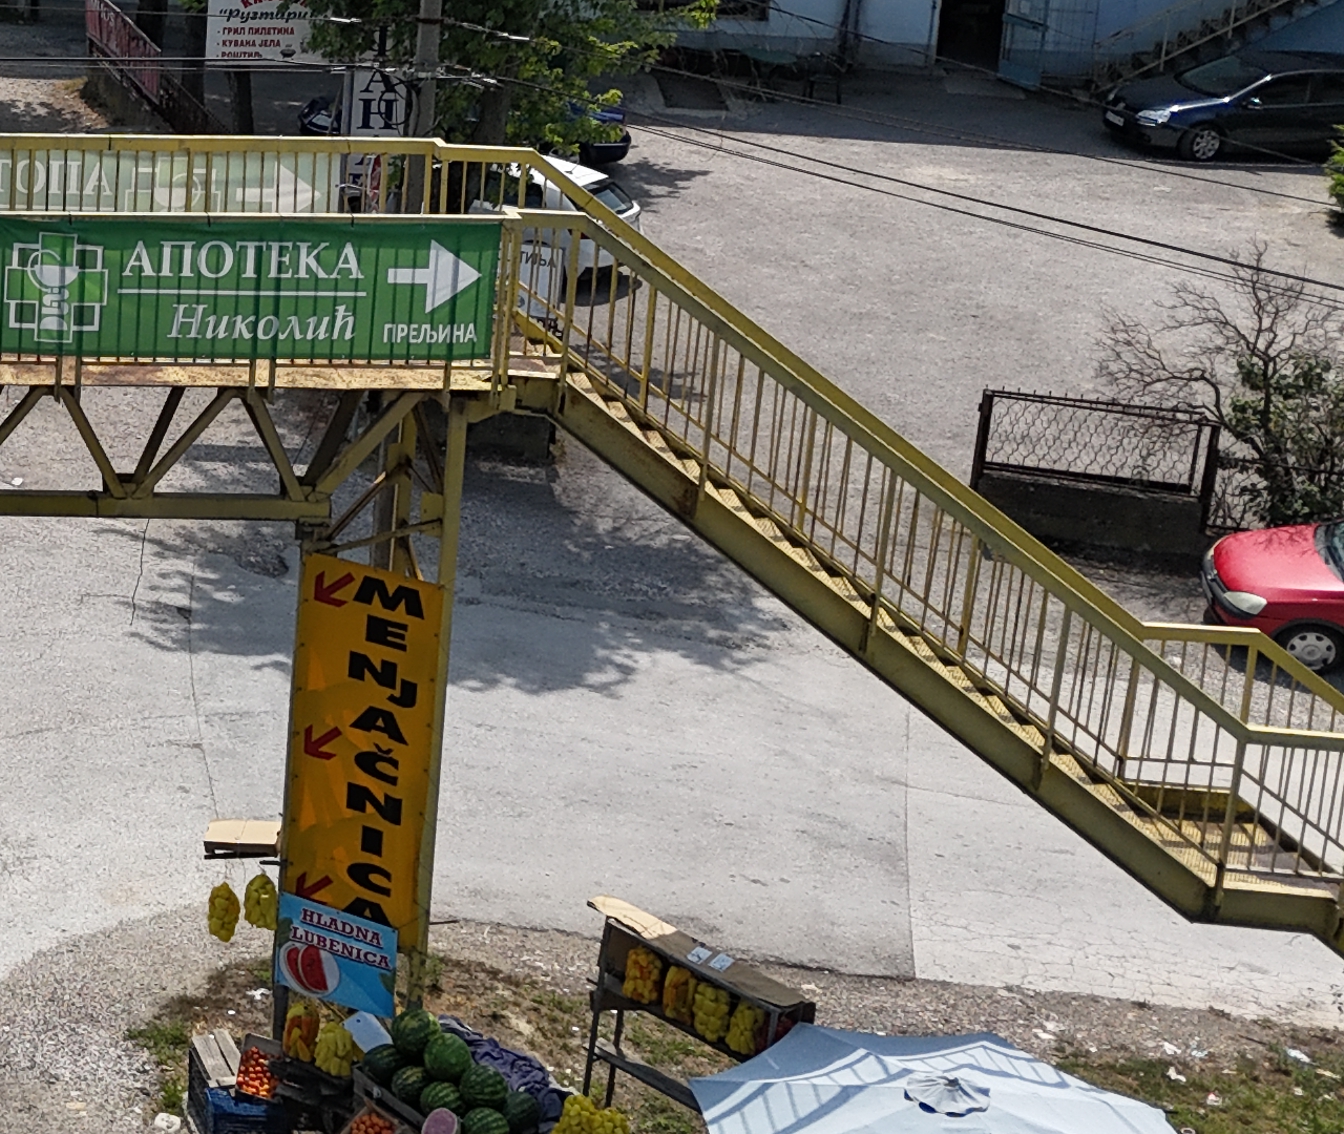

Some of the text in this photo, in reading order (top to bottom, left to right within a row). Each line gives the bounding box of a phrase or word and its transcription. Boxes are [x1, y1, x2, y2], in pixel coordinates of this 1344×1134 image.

[222, 27, 295, 35] ГРИЛ ПИЛЕТИНА
[222, 39, 257, 47] КУВАНА
[120, 240, 365, 279] АПОТЕКА
[167, 302, 357, 340] Николић
[382, 323, 478, 344] ПРЕЉИНА
[341, 575, 425, 928] MENJAČNICA
[300, 907, 384, 949] HLADNA
[289, 926, 391, 971] LUBENICA
